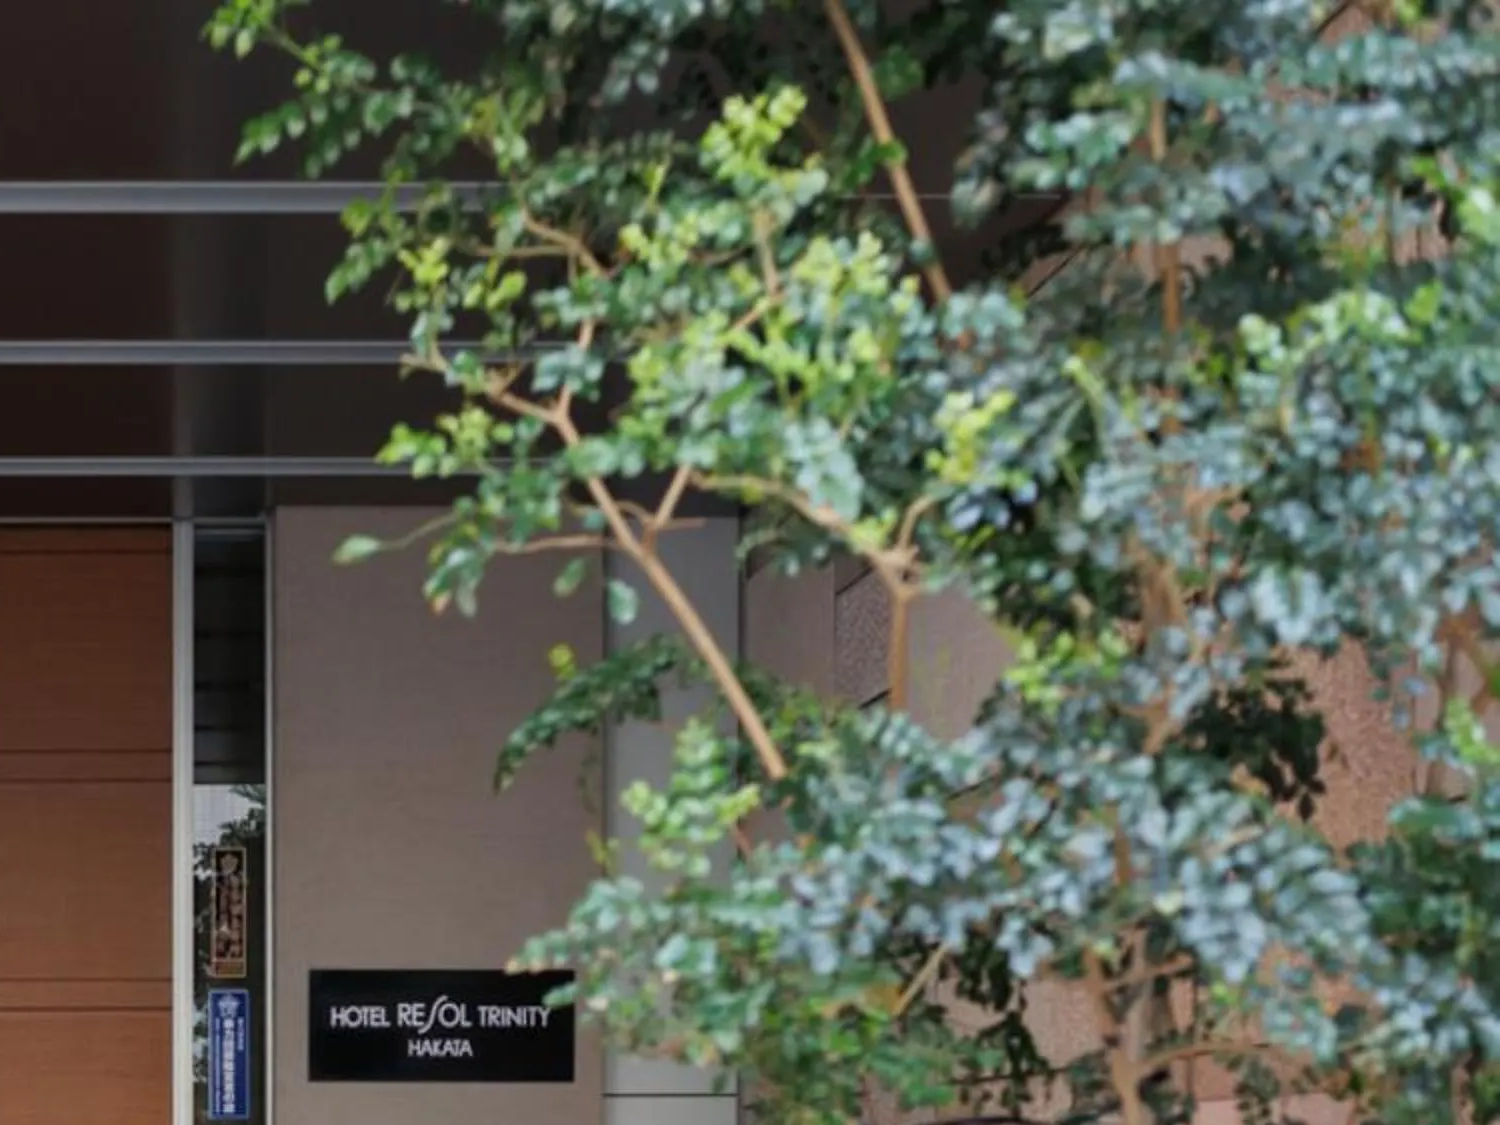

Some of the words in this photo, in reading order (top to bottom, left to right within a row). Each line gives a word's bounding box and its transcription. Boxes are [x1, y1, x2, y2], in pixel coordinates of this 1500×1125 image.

[330, 1005, 391, 1028] HOTEL
[397, 995, 472, 1035] RESOL
[478, 1005, 551, 1028] TRINITY
[408, 1039, 473, 1057] HAKATA
